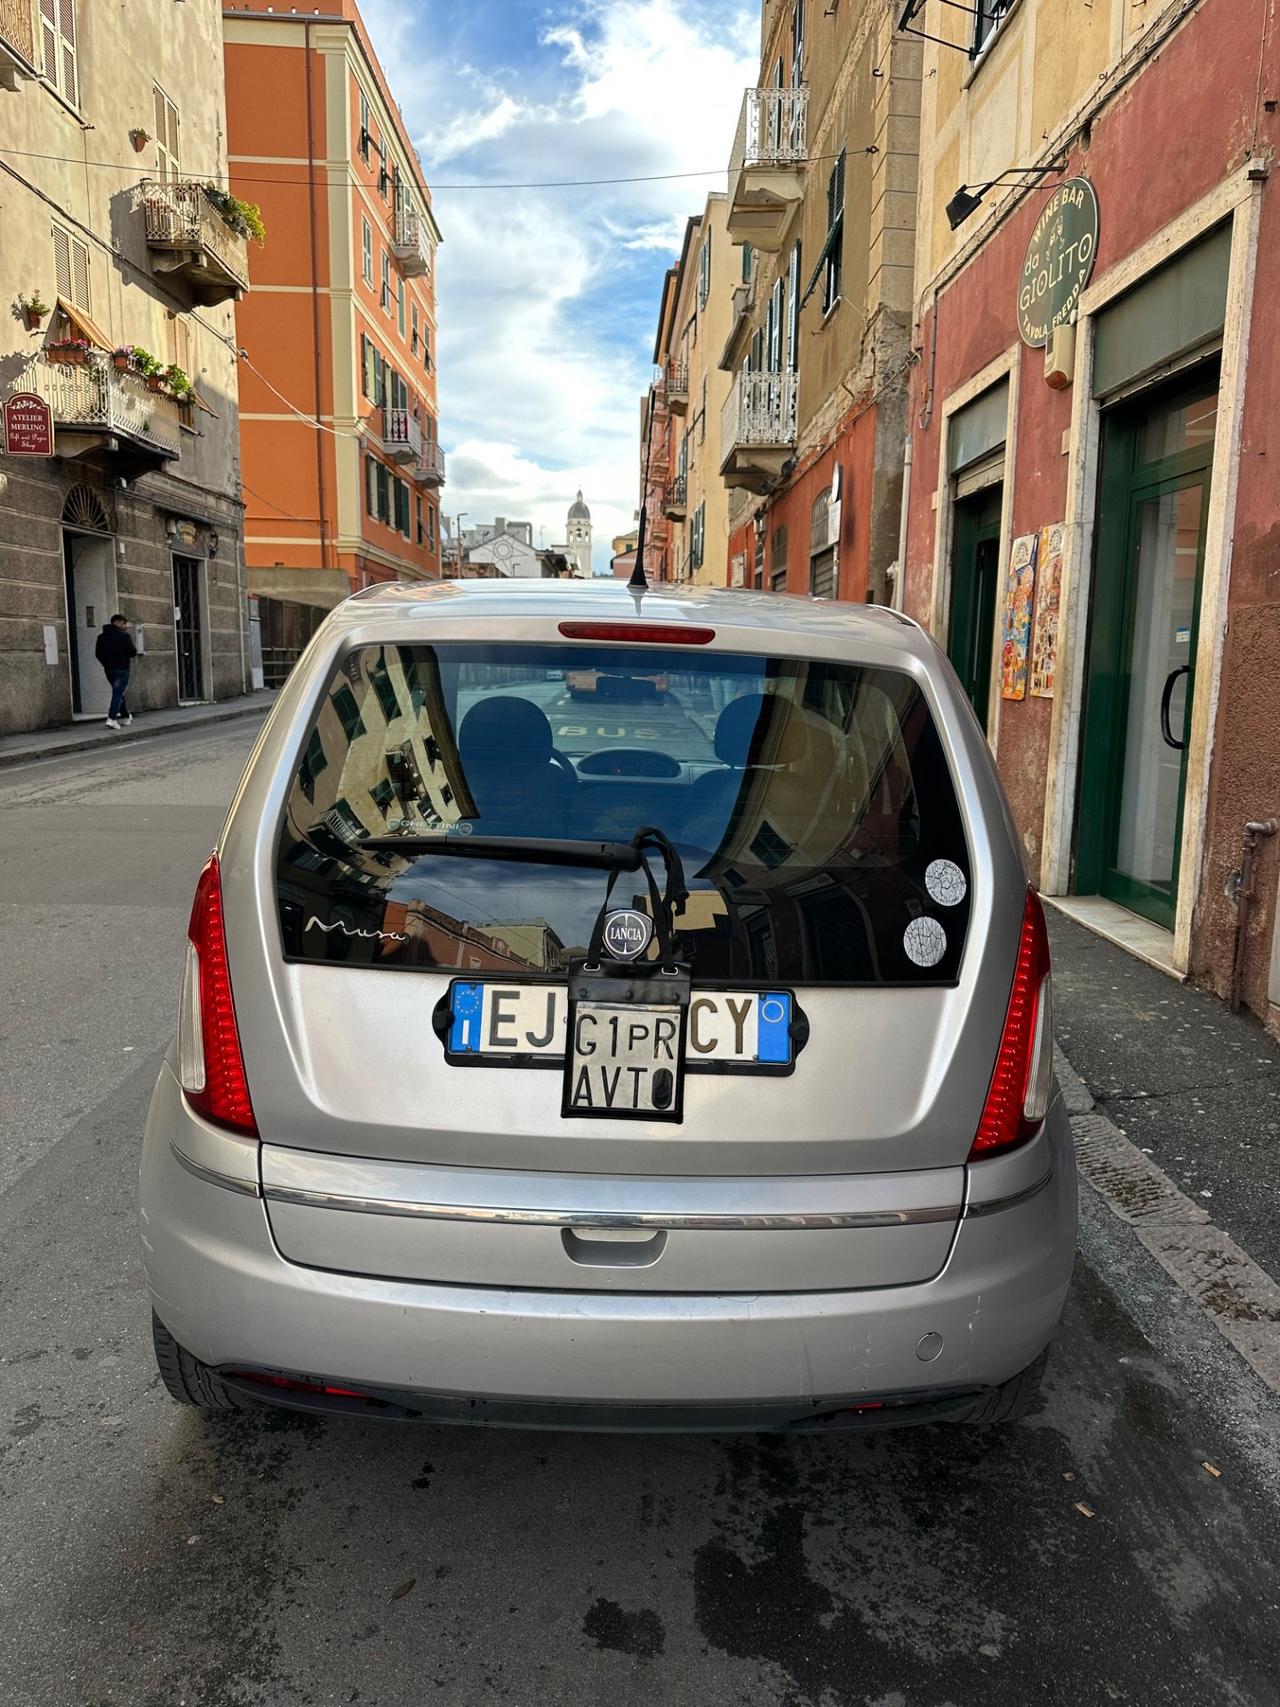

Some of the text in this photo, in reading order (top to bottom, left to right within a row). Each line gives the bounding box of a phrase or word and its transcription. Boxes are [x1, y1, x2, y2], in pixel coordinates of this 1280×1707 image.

[1033, 187, 1085, 243] WINE BAR
[1020, 233, 1093, 311] GIOLITO
[1024, 251, 1040, 276] da
[1022, 268, 1086, 339] TAVOLA FREDDA
[11, 423, 46, 431] MERLINO
[12, 414, 43, 422] ATELIER
[558, 726, 657, 740] BUS
[305, 915, 407, 942] Musa
[610, 927, 642, 941] LANCIA
[488, 990, 556, 1048] EJ
[690, 998, 753, 1055] CY
